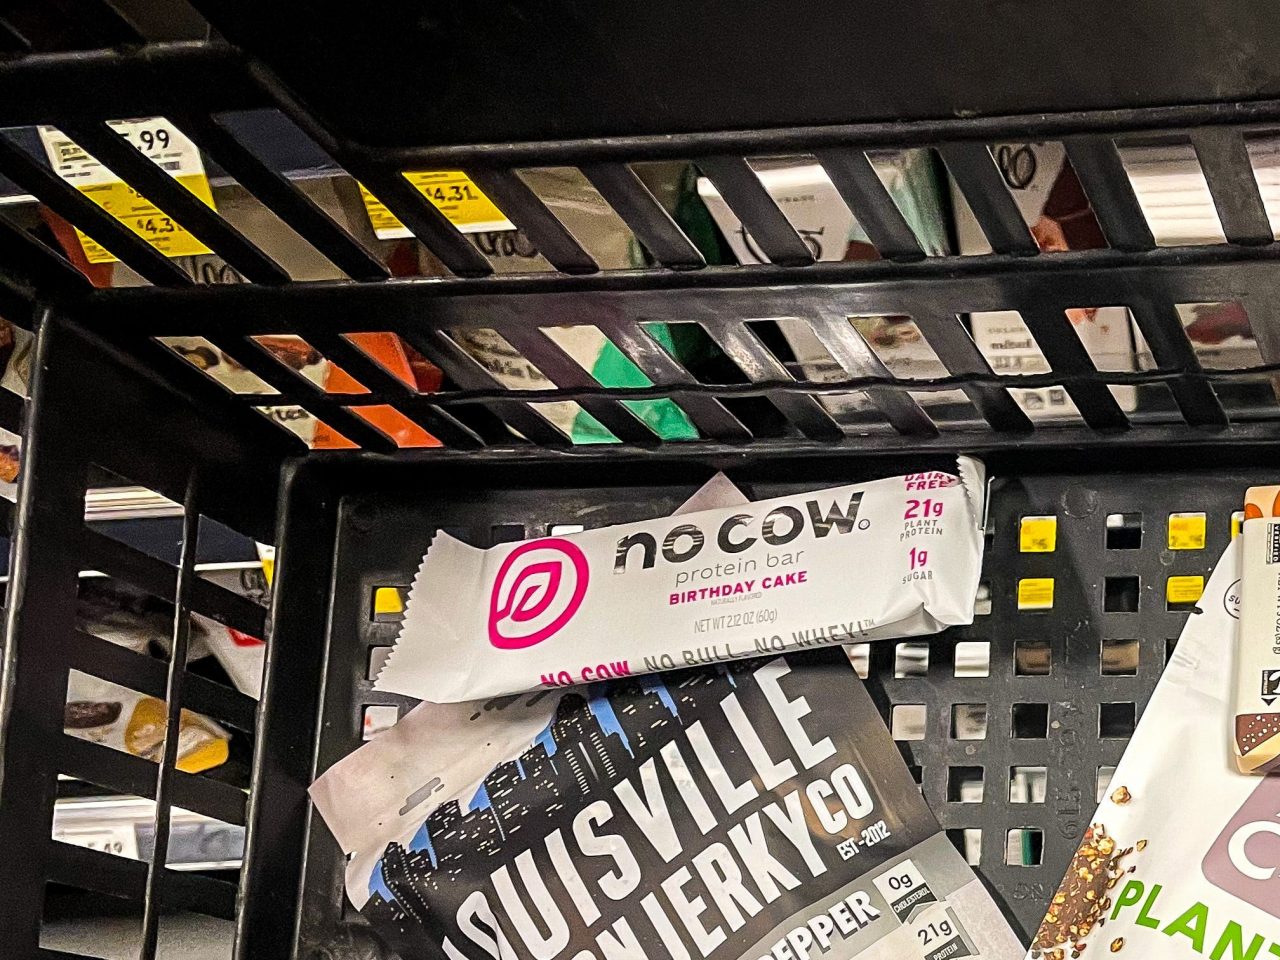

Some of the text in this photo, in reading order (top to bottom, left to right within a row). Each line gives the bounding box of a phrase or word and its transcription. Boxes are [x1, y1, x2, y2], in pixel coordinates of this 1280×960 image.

[906, 480, 950, 492] FREE
[904, 498, 943, 520] 21g
[900, 527, 943, 542] PROTEIN
[905, 519, 938, 531] PLANT
[613, 524, 705, 575] no
[909, 547, 928, 571] 1g
[675, 551, 805, 588] protein bar
[902, 571, 933, 585] SUGAR
[669, 570, 808, 606] BIRTHDAY CAKE
[694, 617, 711, 634] NET
[712, 615, 726, 631] WT
[743, 611, 755, 626] OZ
[755, 608, 778, 624] (60g)
[643, 654, 676, 671] NO
[754, 635, 786, 653] NO
[888, 873, 913, 890] 0g
[893, 887, 931, 914] CHOLESTEROL
[917, 920, 953, 946] 21g
